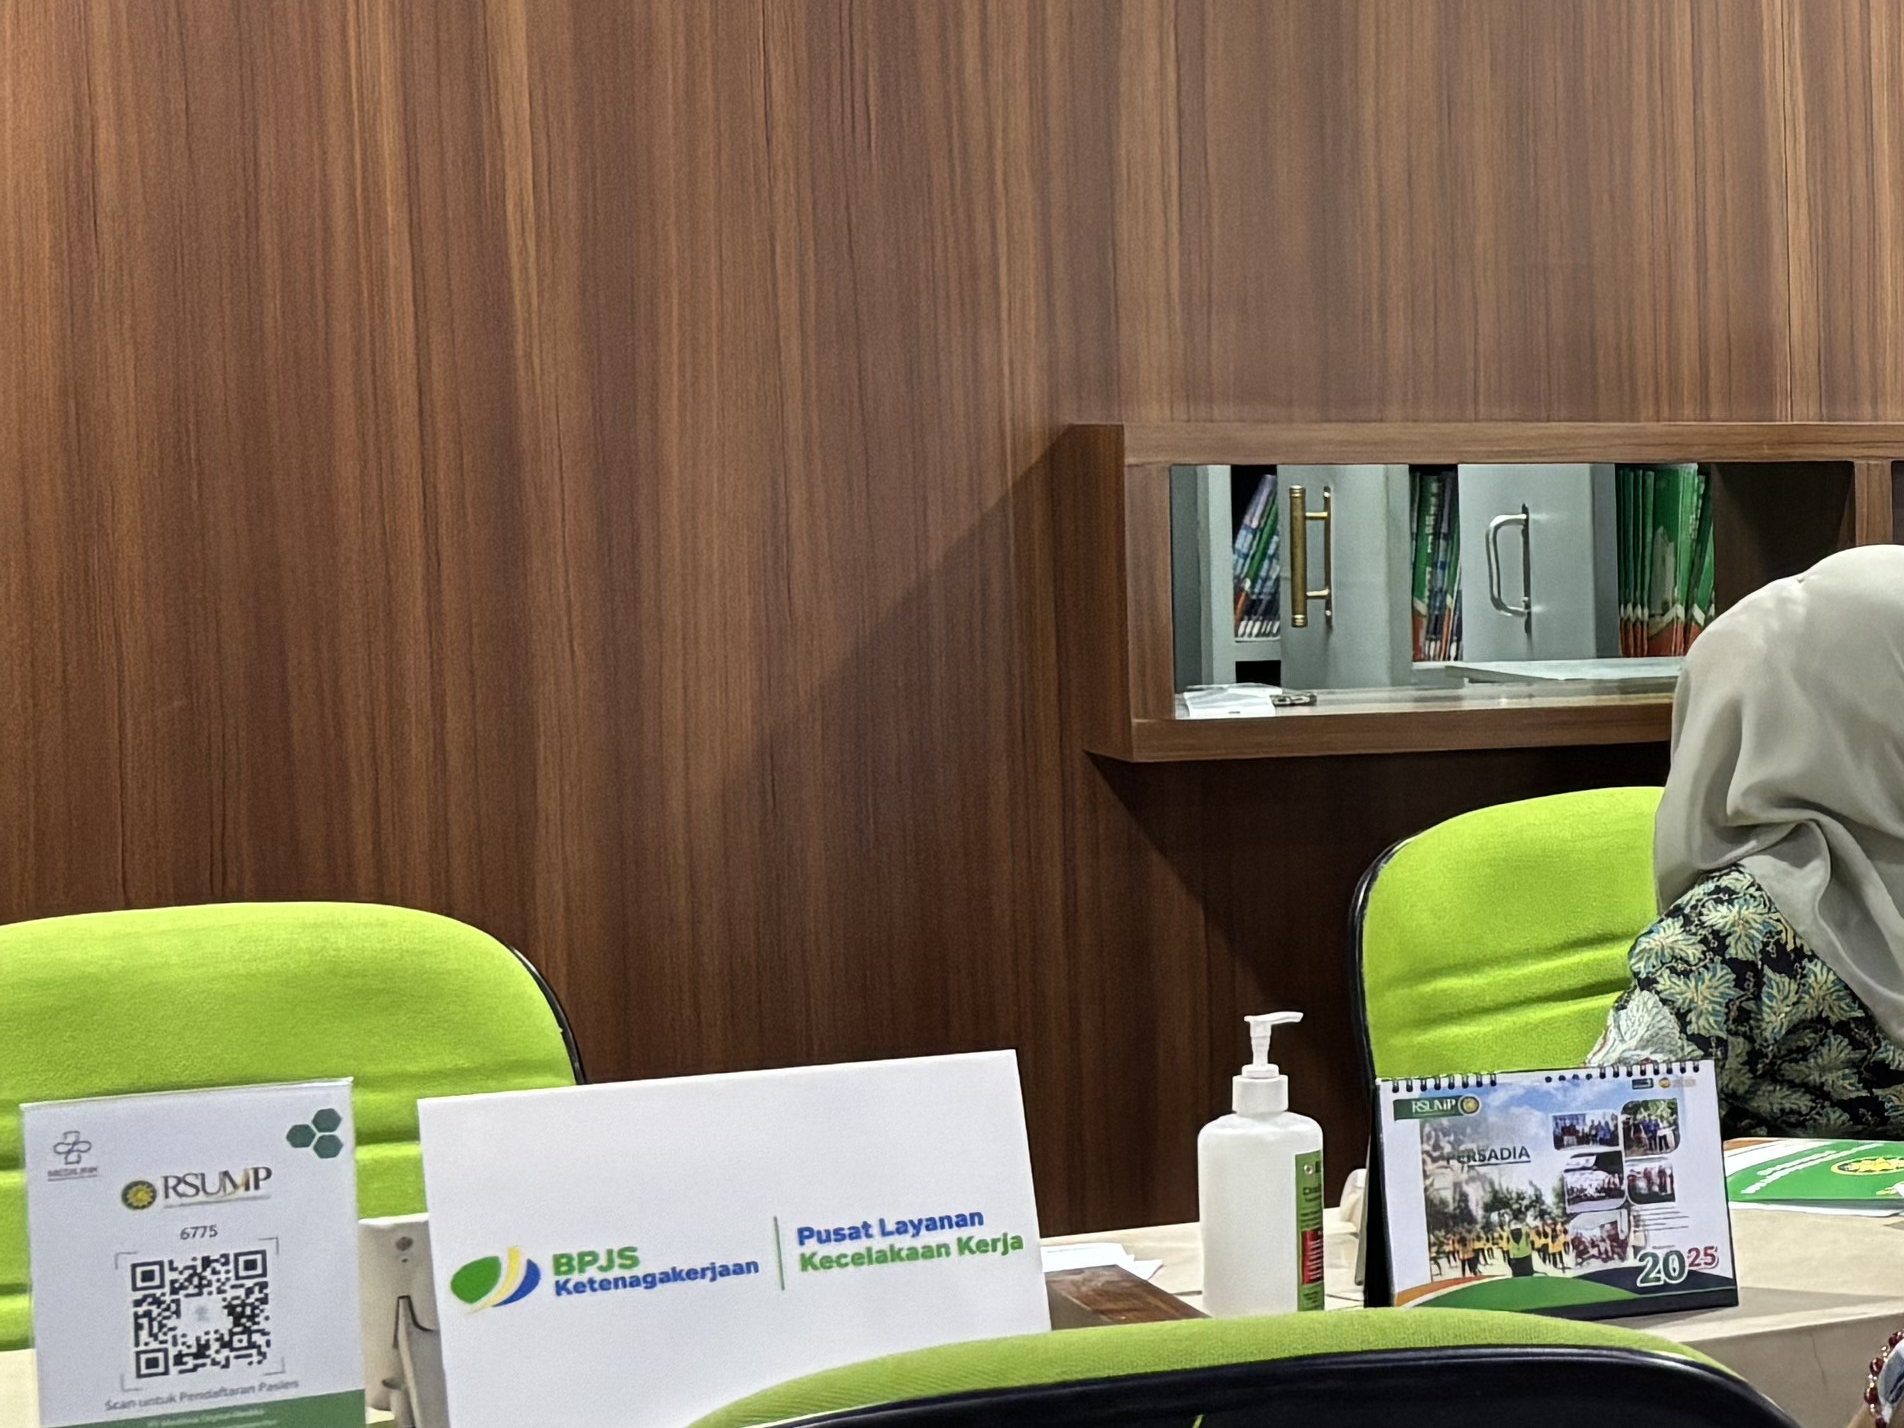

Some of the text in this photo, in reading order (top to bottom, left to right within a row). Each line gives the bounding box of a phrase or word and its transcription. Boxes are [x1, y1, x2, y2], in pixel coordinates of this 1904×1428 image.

[162, 1166, 273, 1200] RSUMP
[180, 1224, 219, 1241] 6775
[796, 1208, 985, 1247] Pusat Layanan
[552, 1245, 641, 1276] BPJS
[799, 1230, 1025, 1274] Kecelakaan Kerja
[554, 1257, 760, 1298] Ketenagakerjaan
[104, 1379, 300, 1411] Scan untuk Pendaftaran Pasien
